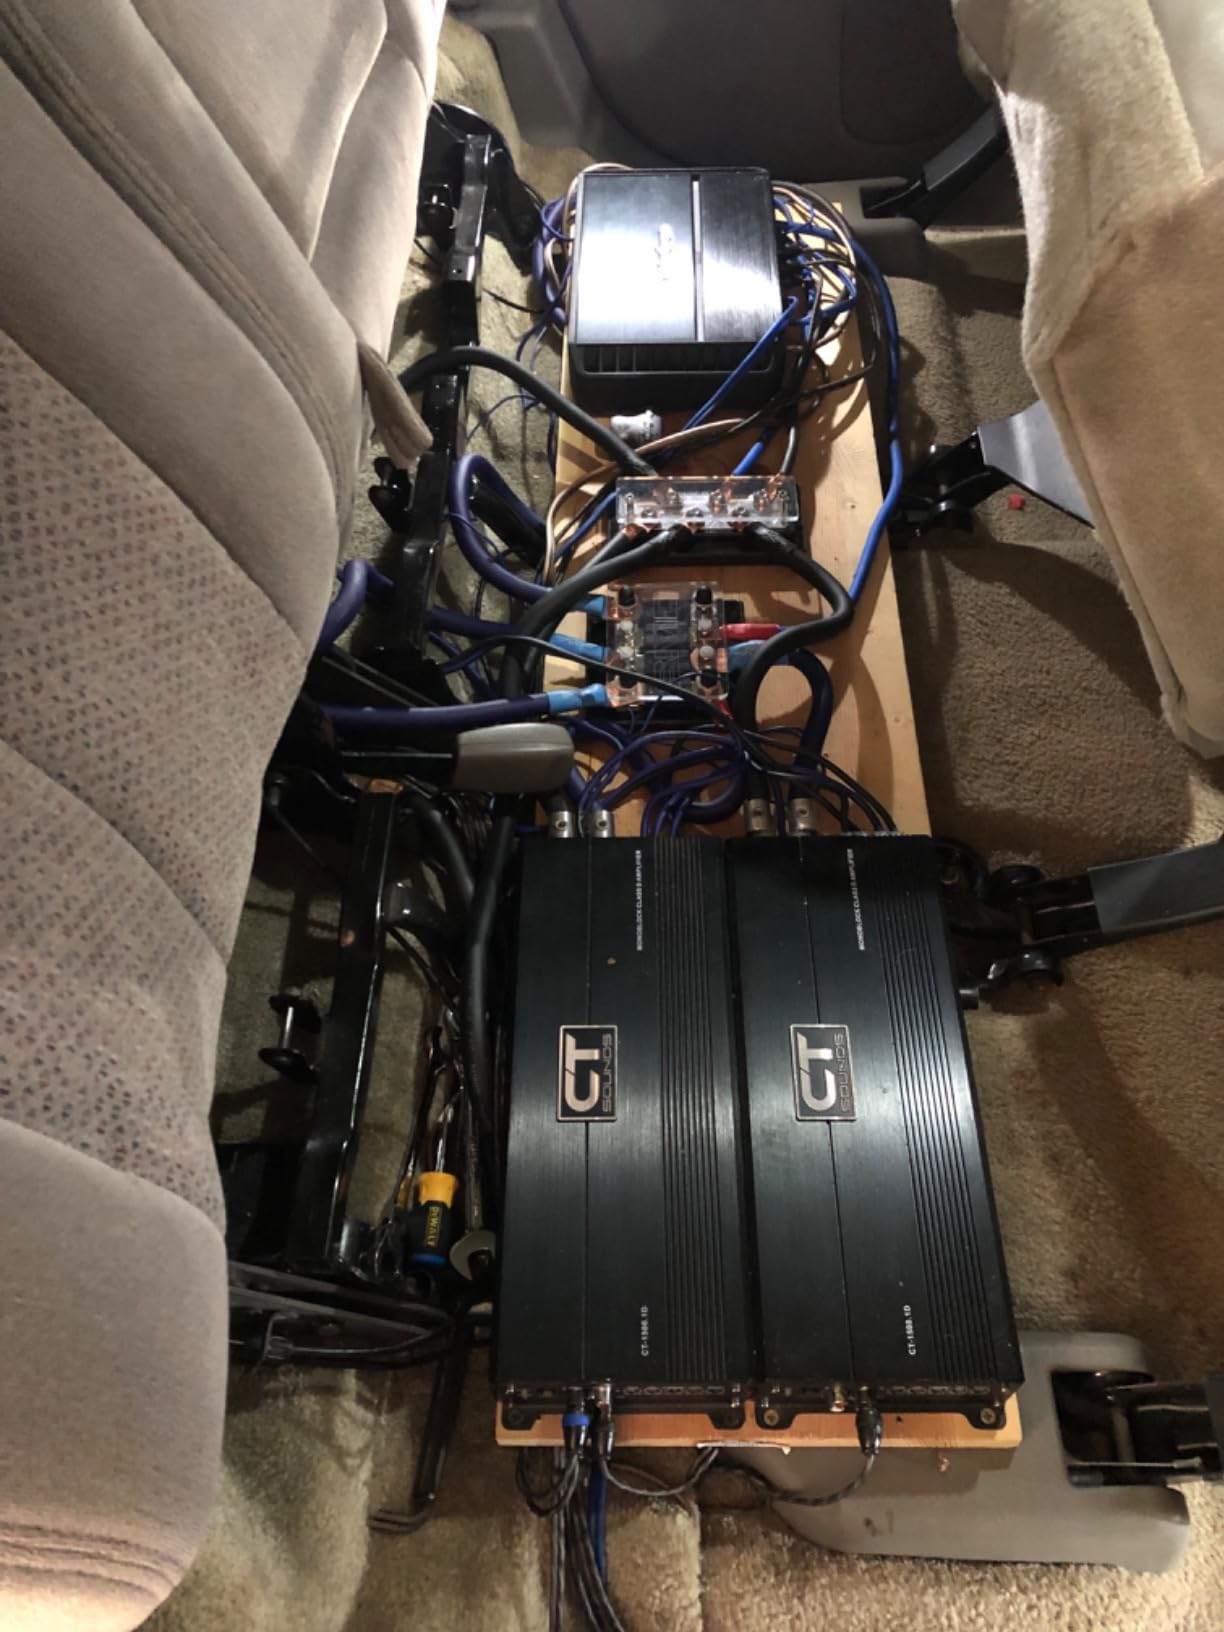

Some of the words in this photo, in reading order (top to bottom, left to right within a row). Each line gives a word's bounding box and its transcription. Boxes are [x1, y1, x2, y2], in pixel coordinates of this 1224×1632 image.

[564, 1033, 601, 1112] CT
[601, 1033, 612, 1112] SOUNDS
[797, 1032, 837, 1111] CT
[834, 1032, 850, 1112] SOUNDS
